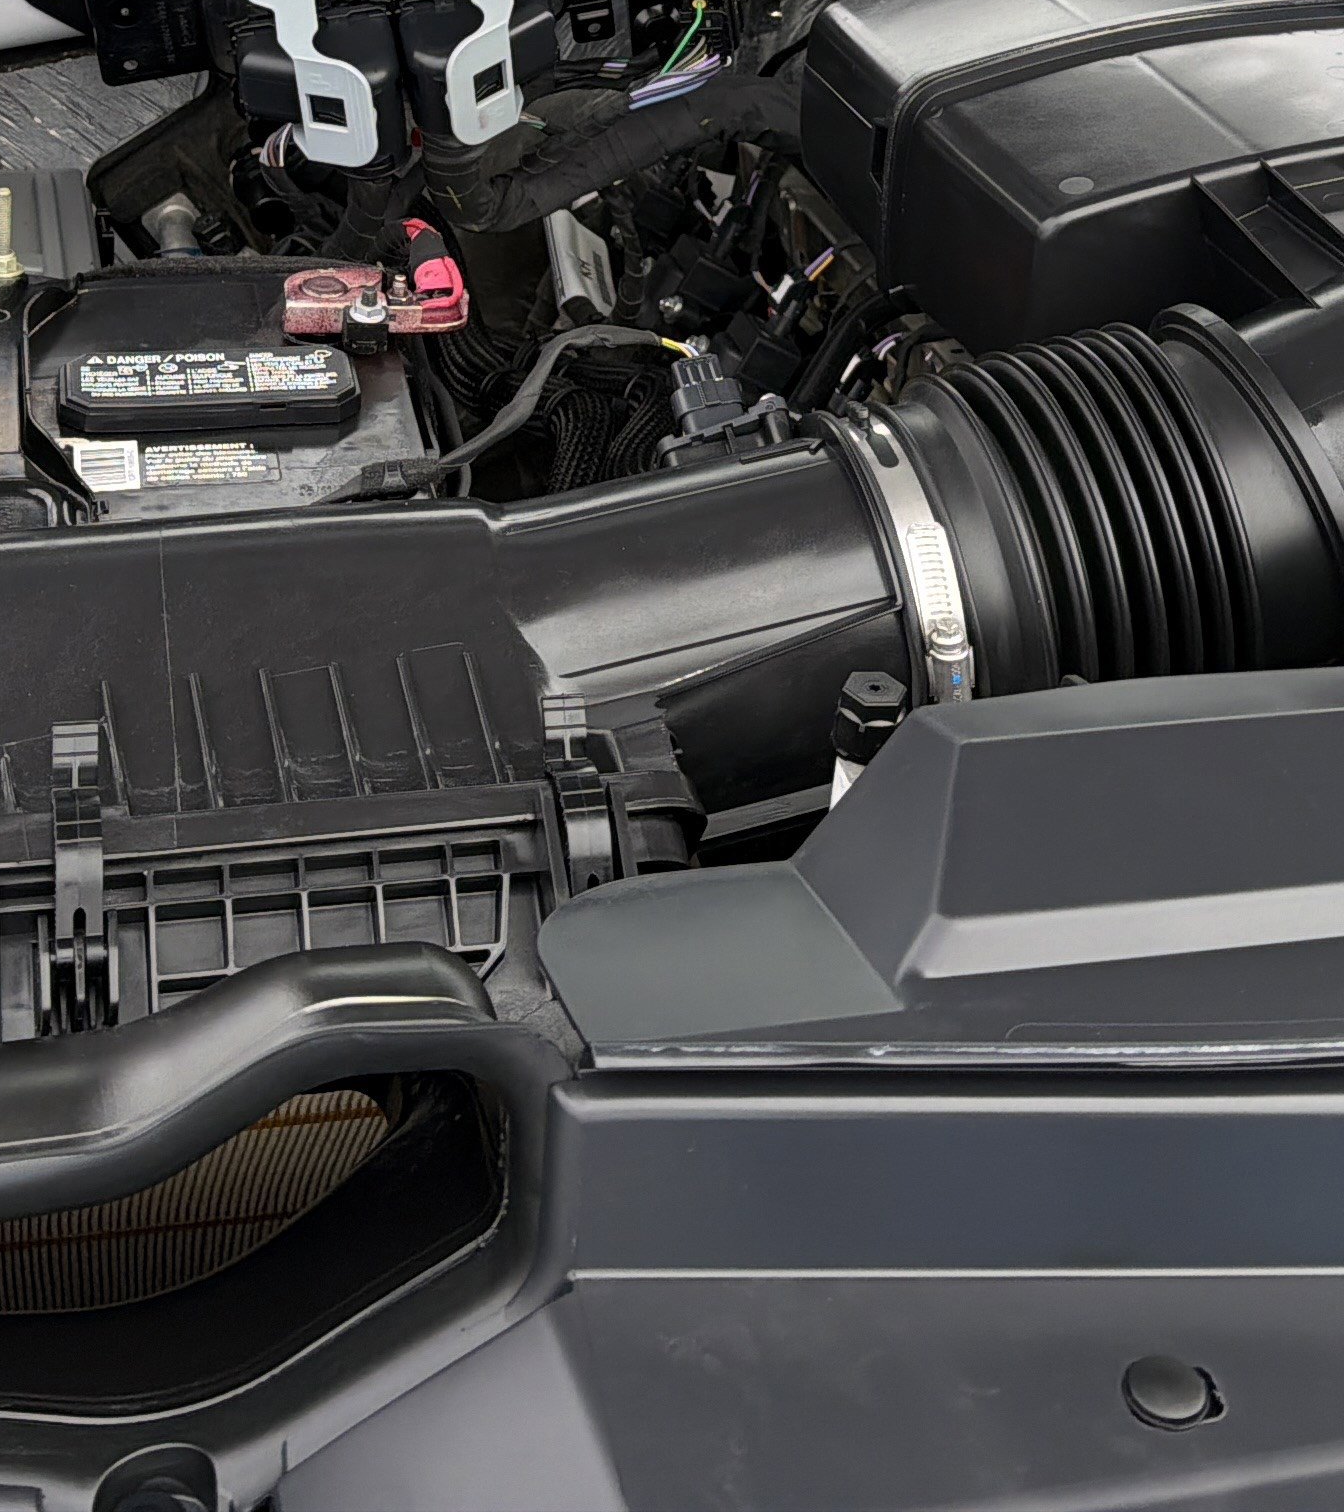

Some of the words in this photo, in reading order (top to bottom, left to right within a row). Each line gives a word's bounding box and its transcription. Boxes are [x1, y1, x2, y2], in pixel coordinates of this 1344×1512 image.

[106, 355, 161, 364] DANGER
[176, 353, 225, 362] POISON
[145, 443, 246, 453] AVERTISSEMENT
